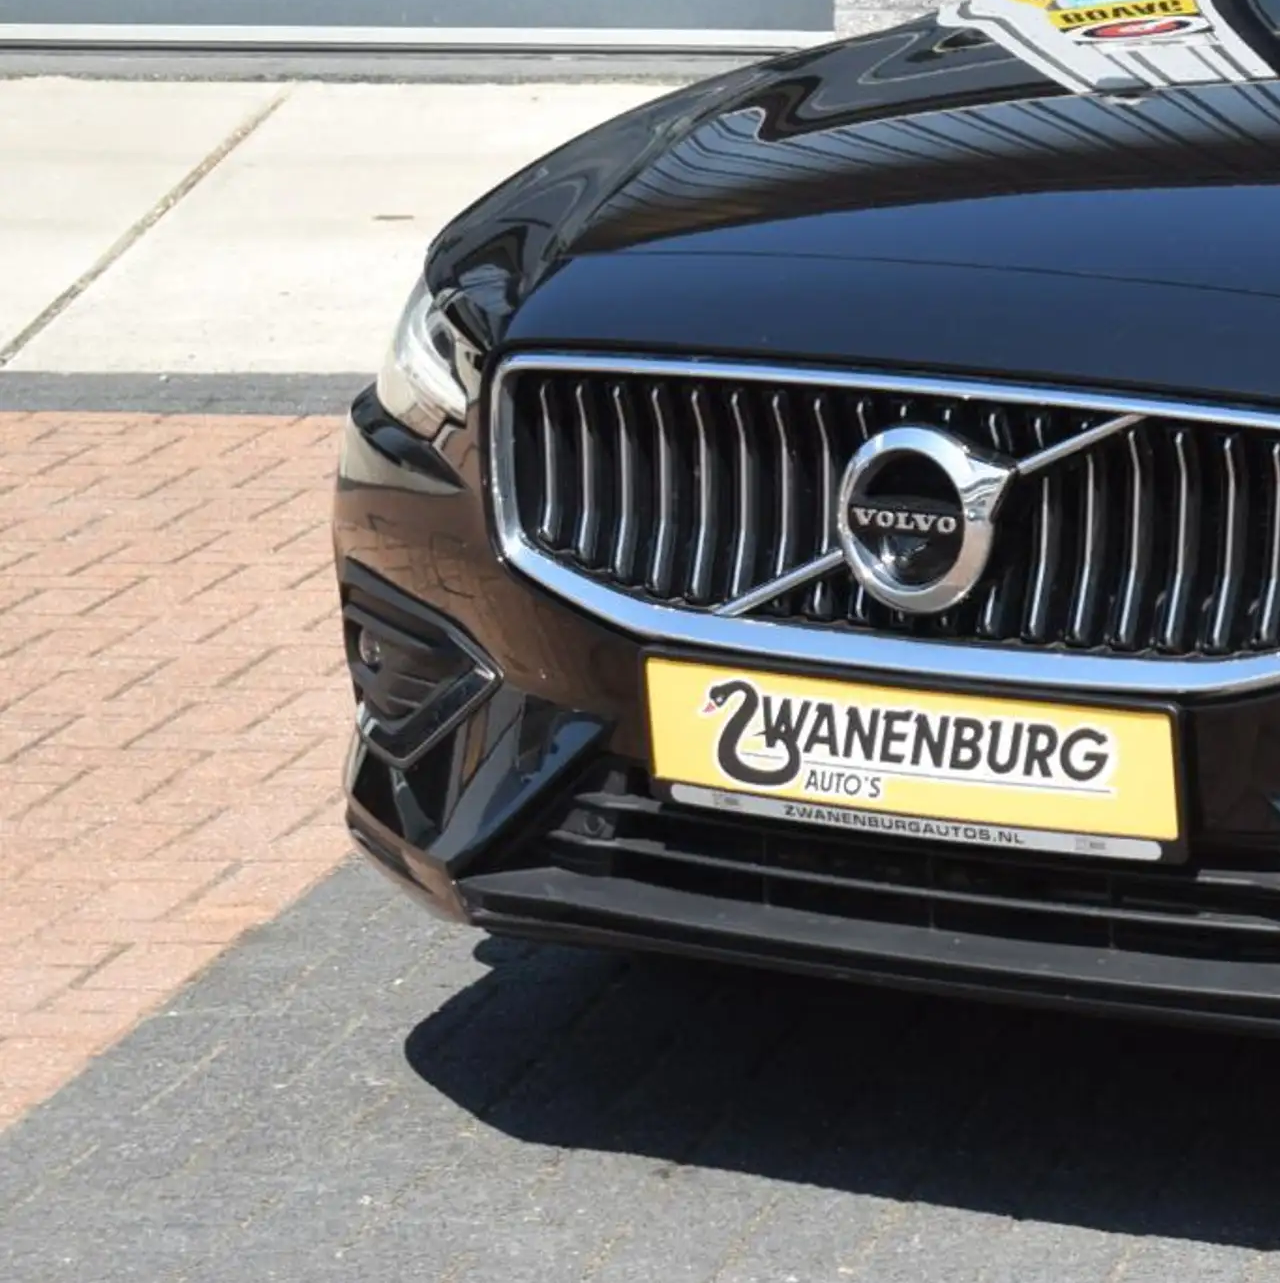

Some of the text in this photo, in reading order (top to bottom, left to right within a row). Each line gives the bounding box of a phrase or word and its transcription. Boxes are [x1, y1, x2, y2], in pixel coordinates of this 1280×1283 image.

[853, 507, 957, 534] VOLVO
[804, 770, 881, 798] AUTO'S
[784, 805, 1025, 844] ZWANENBURGAUTOS.NL
